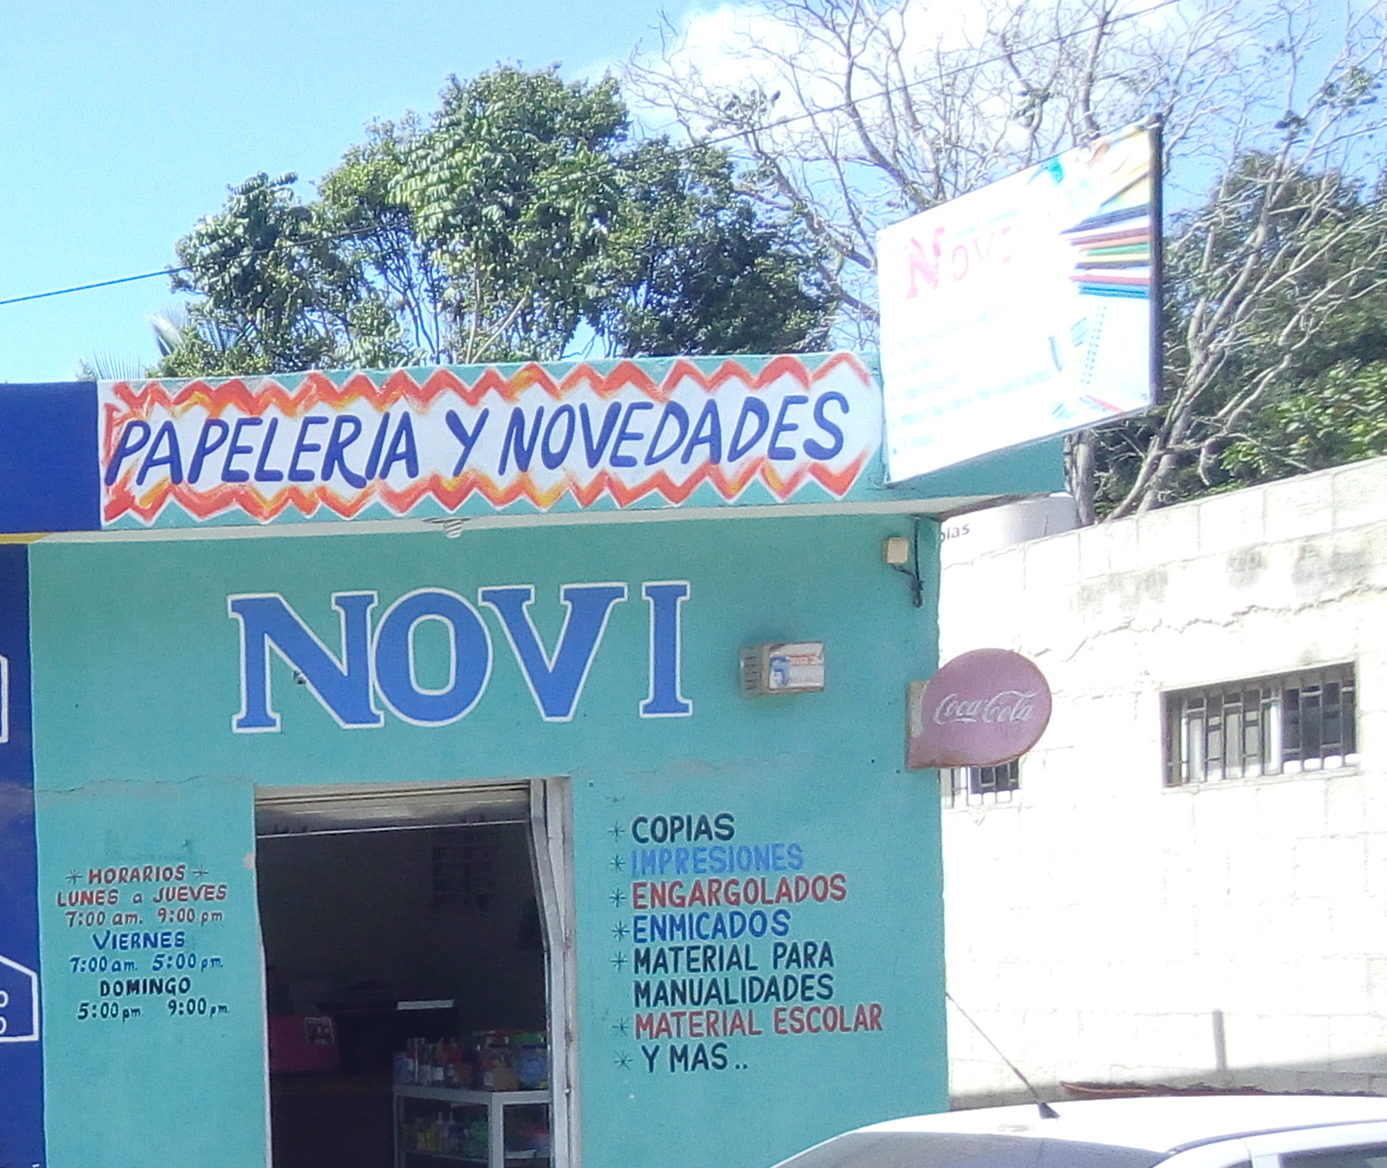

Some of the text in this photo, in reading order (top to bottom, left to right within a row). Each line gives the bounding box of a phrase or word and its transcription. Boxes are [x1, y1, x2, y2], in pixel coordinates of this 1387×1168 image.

[105, 391, 851, 489] PAPELERIA Y NOVEDADES
[227, 580, 694, 734] NOVI
[631, 813, 735, 843] COPIAS
[630, 842, 805, 876] IMPRESIONES
[88, 865, 187, 884] HORARIOS
[57, 884, 228, 907] LUNES a JUEVES
[631, 873, 847, 910] ENGARGOLADOS
[66, 911, 105, 927] 7:00
[112, 913, 143, 925] am.
[157, 907, 195, 923] 9:00
[632, 908, 792, 943] ENMICADOS
[92, 930, 185, 950] VIERNES
[69, 956, 107, 973] 7:00
[152, 953, 196, 971] 5:00
[633, 940, 835, 975] MATERIAL PARA
[100, 977, 191, 997] DOMINGO
[633, 973, 835, 1007] MANUALIDADES
[77, 1002, 119, 1020] 5:00
[168, 998, 207, 1015] 9:00
[634, 1002, 883, 1040] MATERIAL ESCOLAR
[641, 1044, 660, 1073] Y
